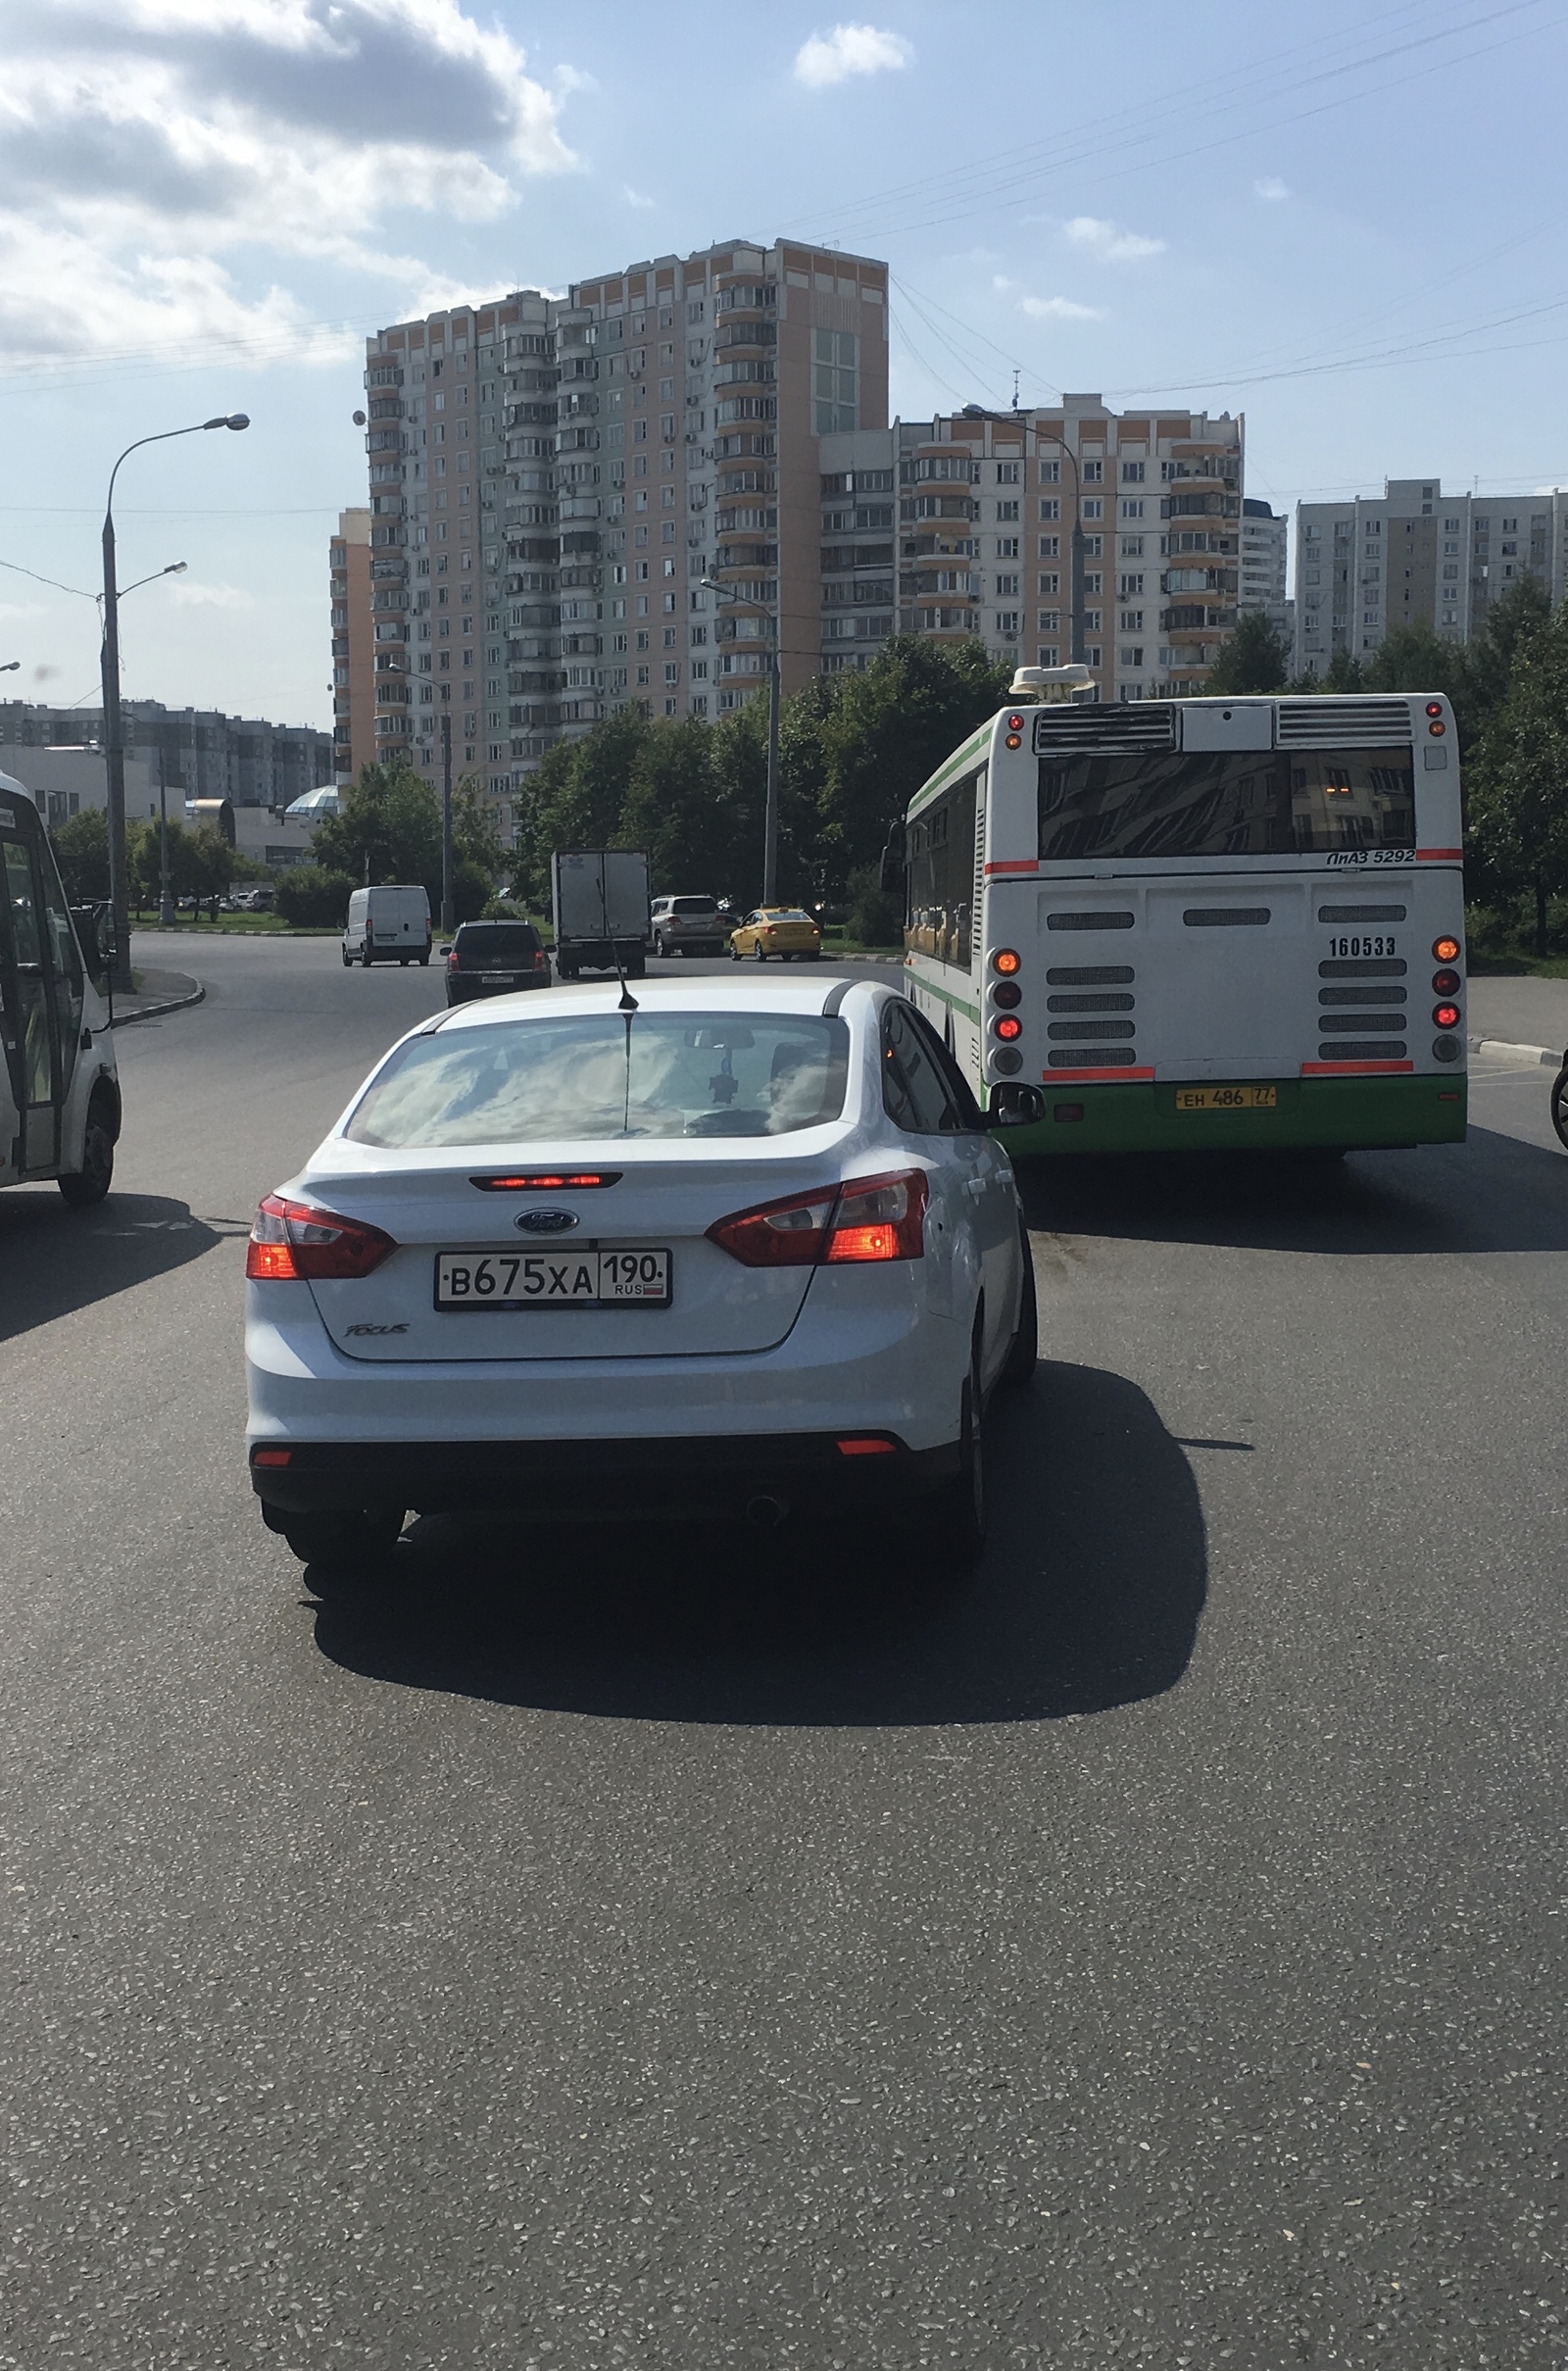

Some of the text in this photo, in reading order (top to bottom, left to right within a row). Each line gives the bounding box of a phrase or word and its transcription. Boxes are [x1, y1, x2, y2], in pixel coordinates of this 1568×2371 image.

[1327, 850, 1415, 864] ЛиАЗ 5292
[1329, 937, 1396, 957] 160533
[1212, 1089, 1244, 1106] 486
[1254, 1088, 1270, 1100] 77
[530, 1212, 565, 1232] Ford
[451, 1255, 658, 1295] В675ХА 190
[614, 1284, 642, 1295] RUS
